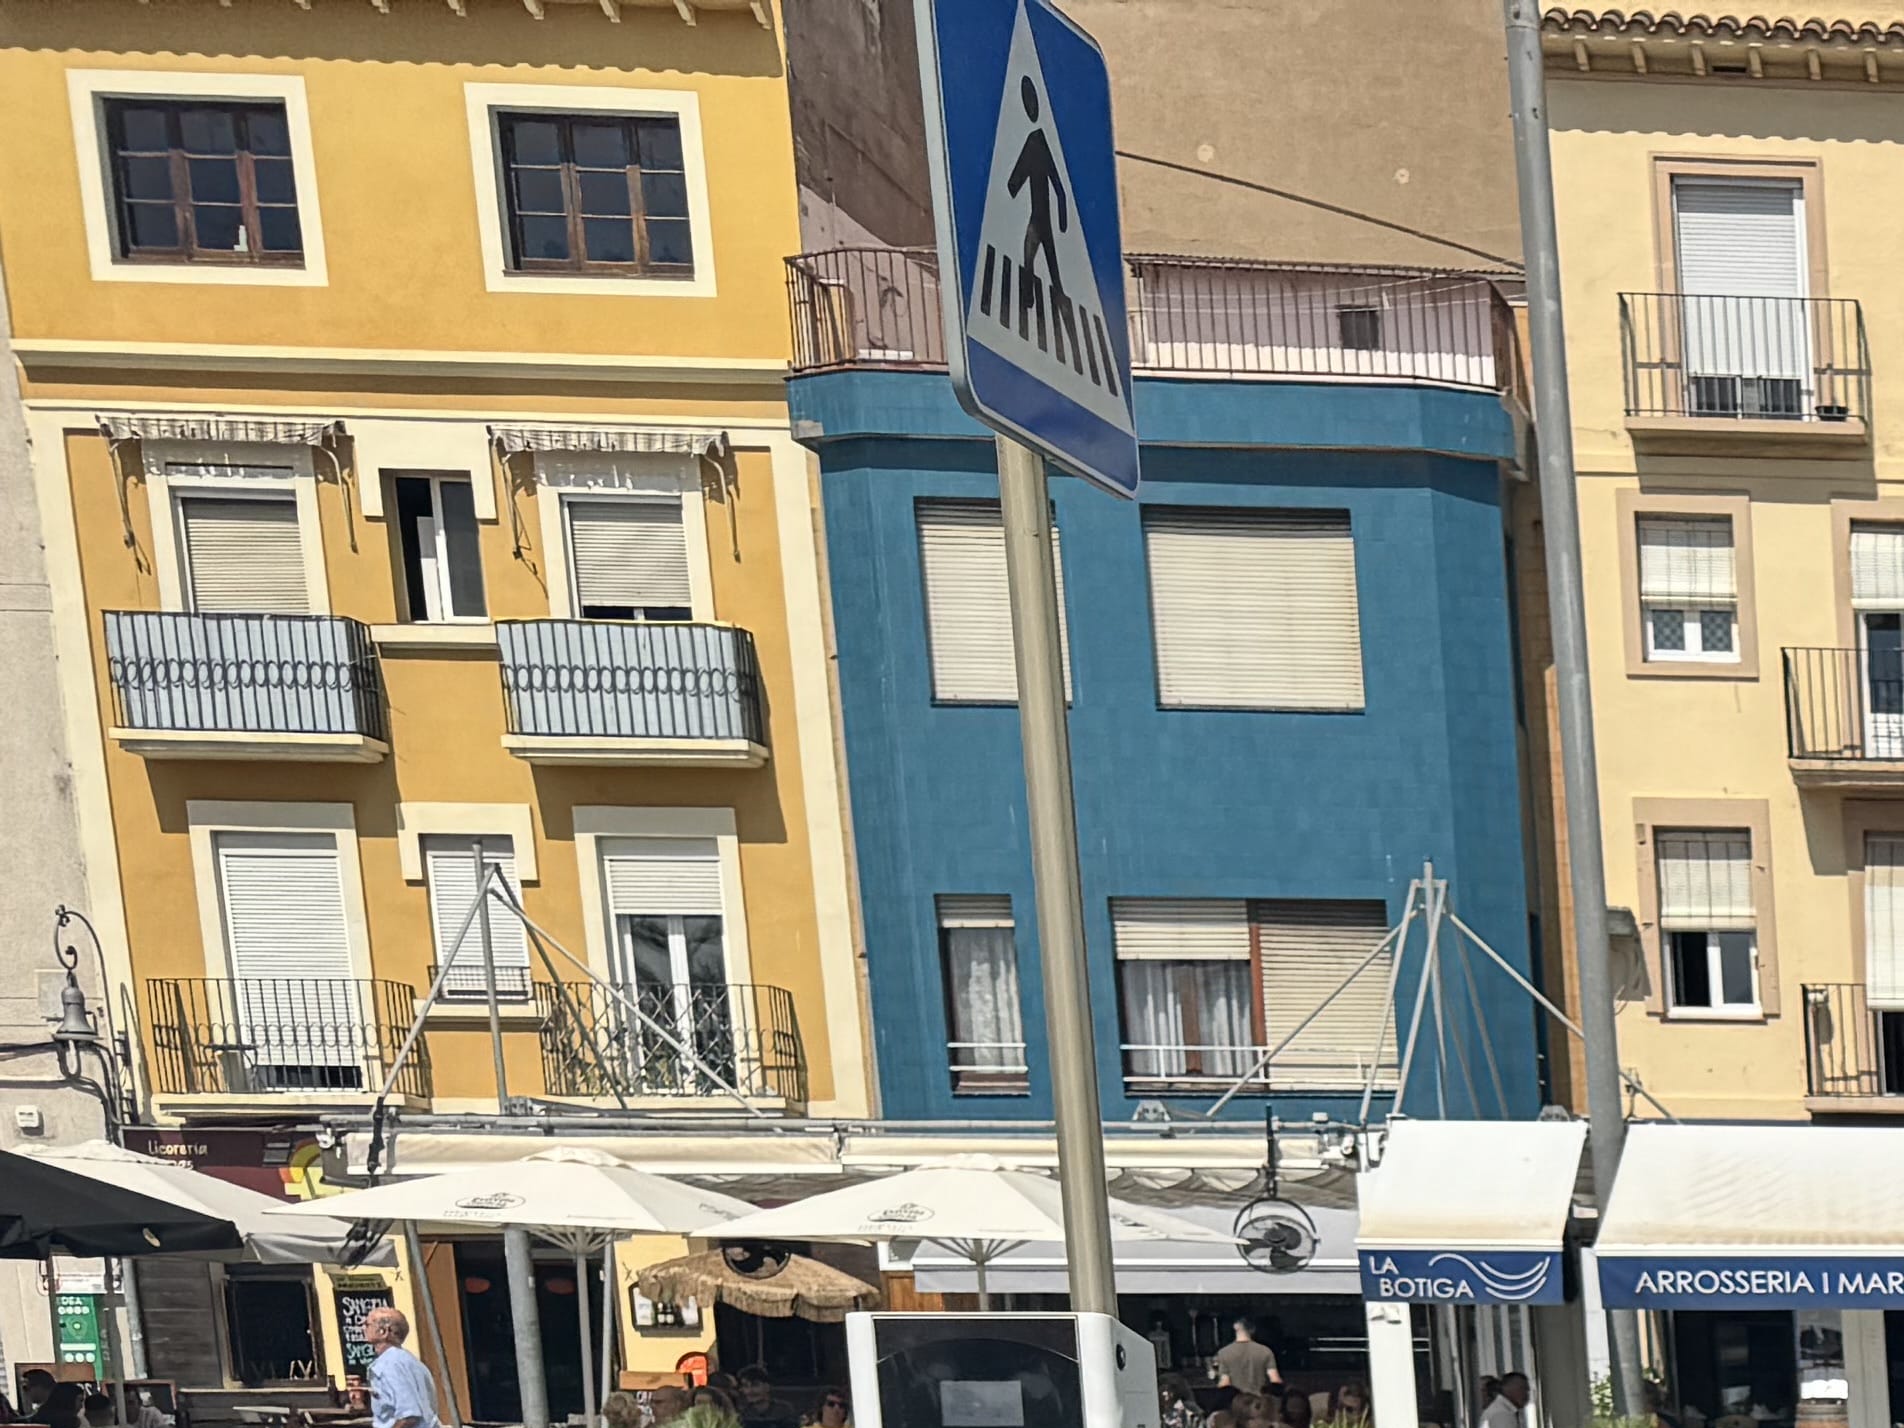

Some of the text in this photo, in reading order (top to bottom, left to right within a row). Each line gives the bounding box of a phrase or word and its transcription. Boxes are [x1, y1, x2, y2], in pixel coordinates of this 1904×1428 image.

[1368, 1255, 1399, 1276] LA
[1379, 1277, 1475, 1299] BOTIGA
[1635, 1270, 1815, 1295] ARROSSERIA
